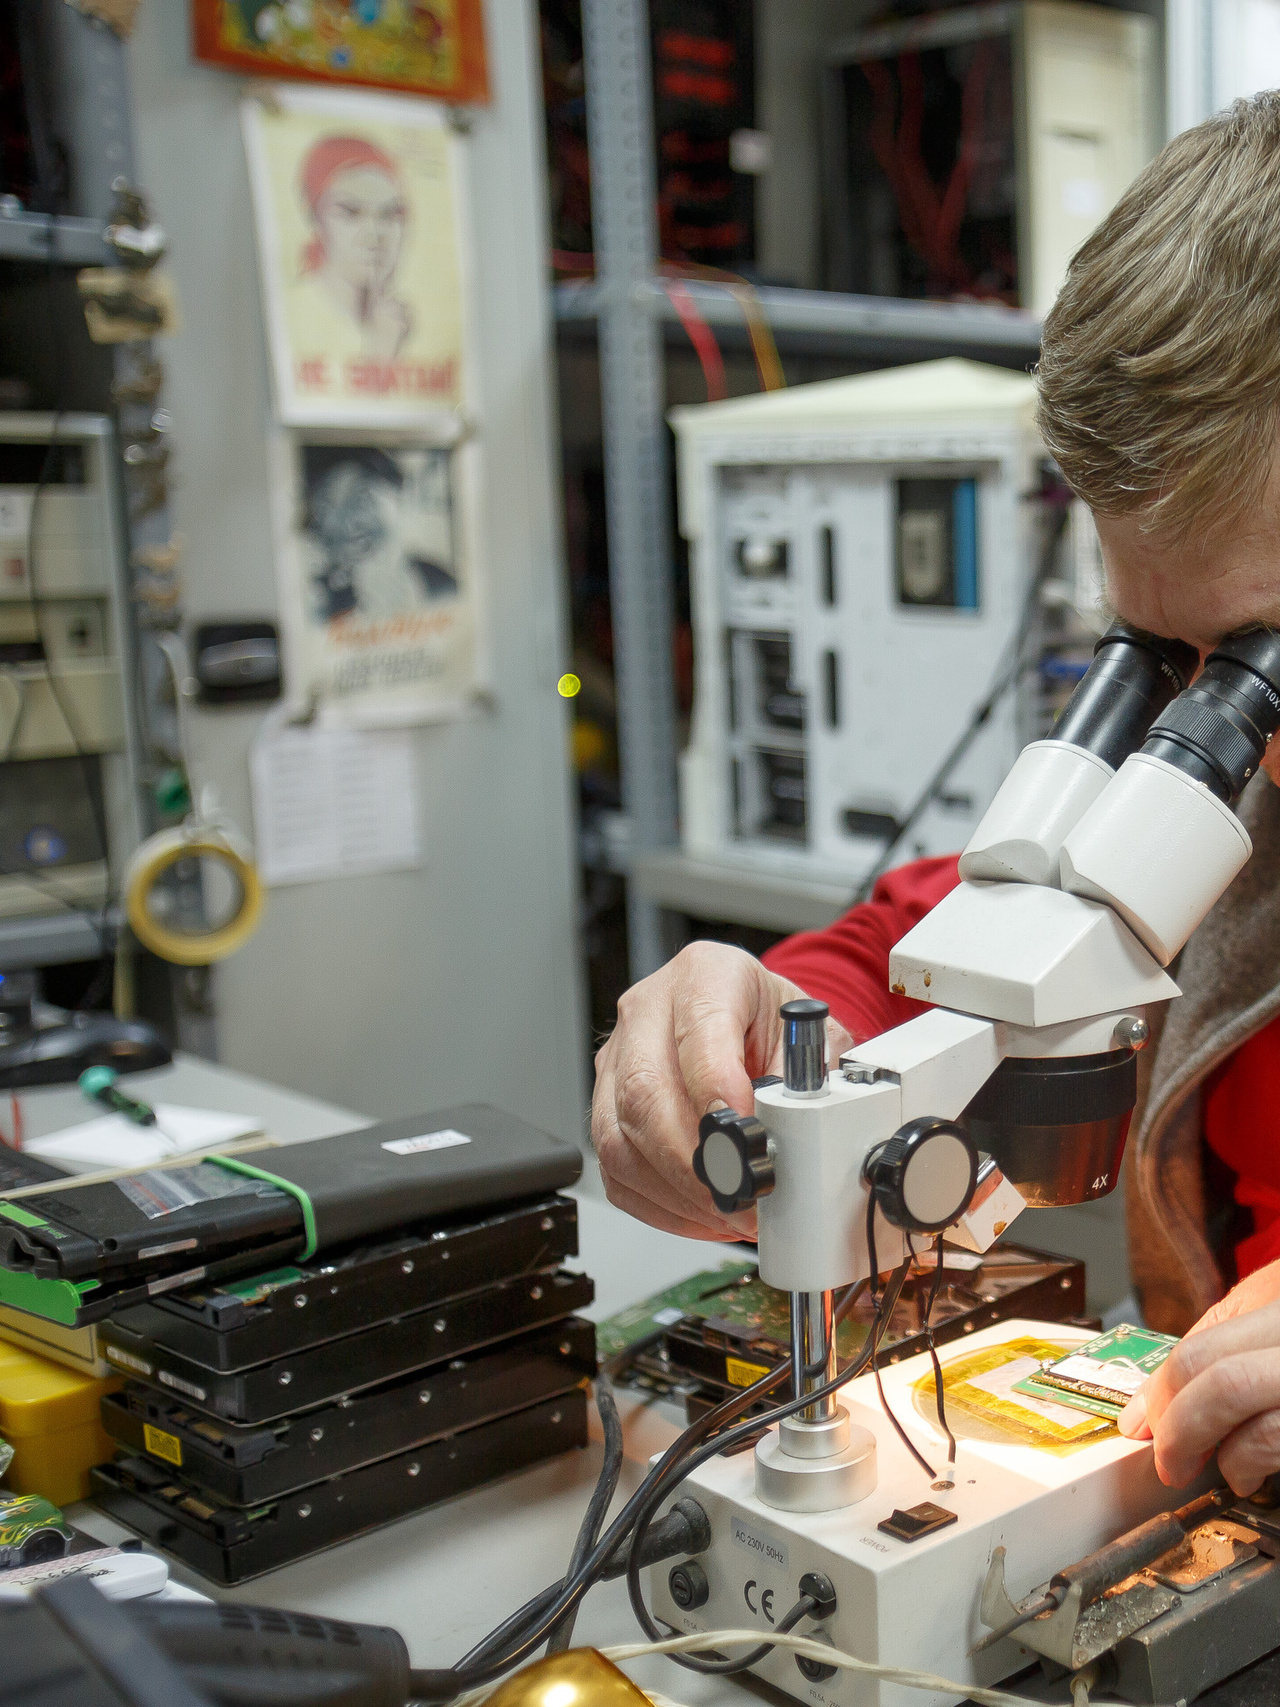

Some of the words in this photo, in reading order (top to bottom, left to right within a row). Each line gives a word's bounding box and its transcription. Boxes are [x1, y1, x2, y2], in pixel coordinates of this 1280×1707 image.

[1092, 1173, 1108, 1190] 4X
[735, 1530, 746, 1543] AC
[747, 1535, 765, 1553] 230V
[766, 1545, 784, 1564] 50Hz
[859, 1536, 890, 1553] POWER
[743, 1579, 775, 1625] CE
